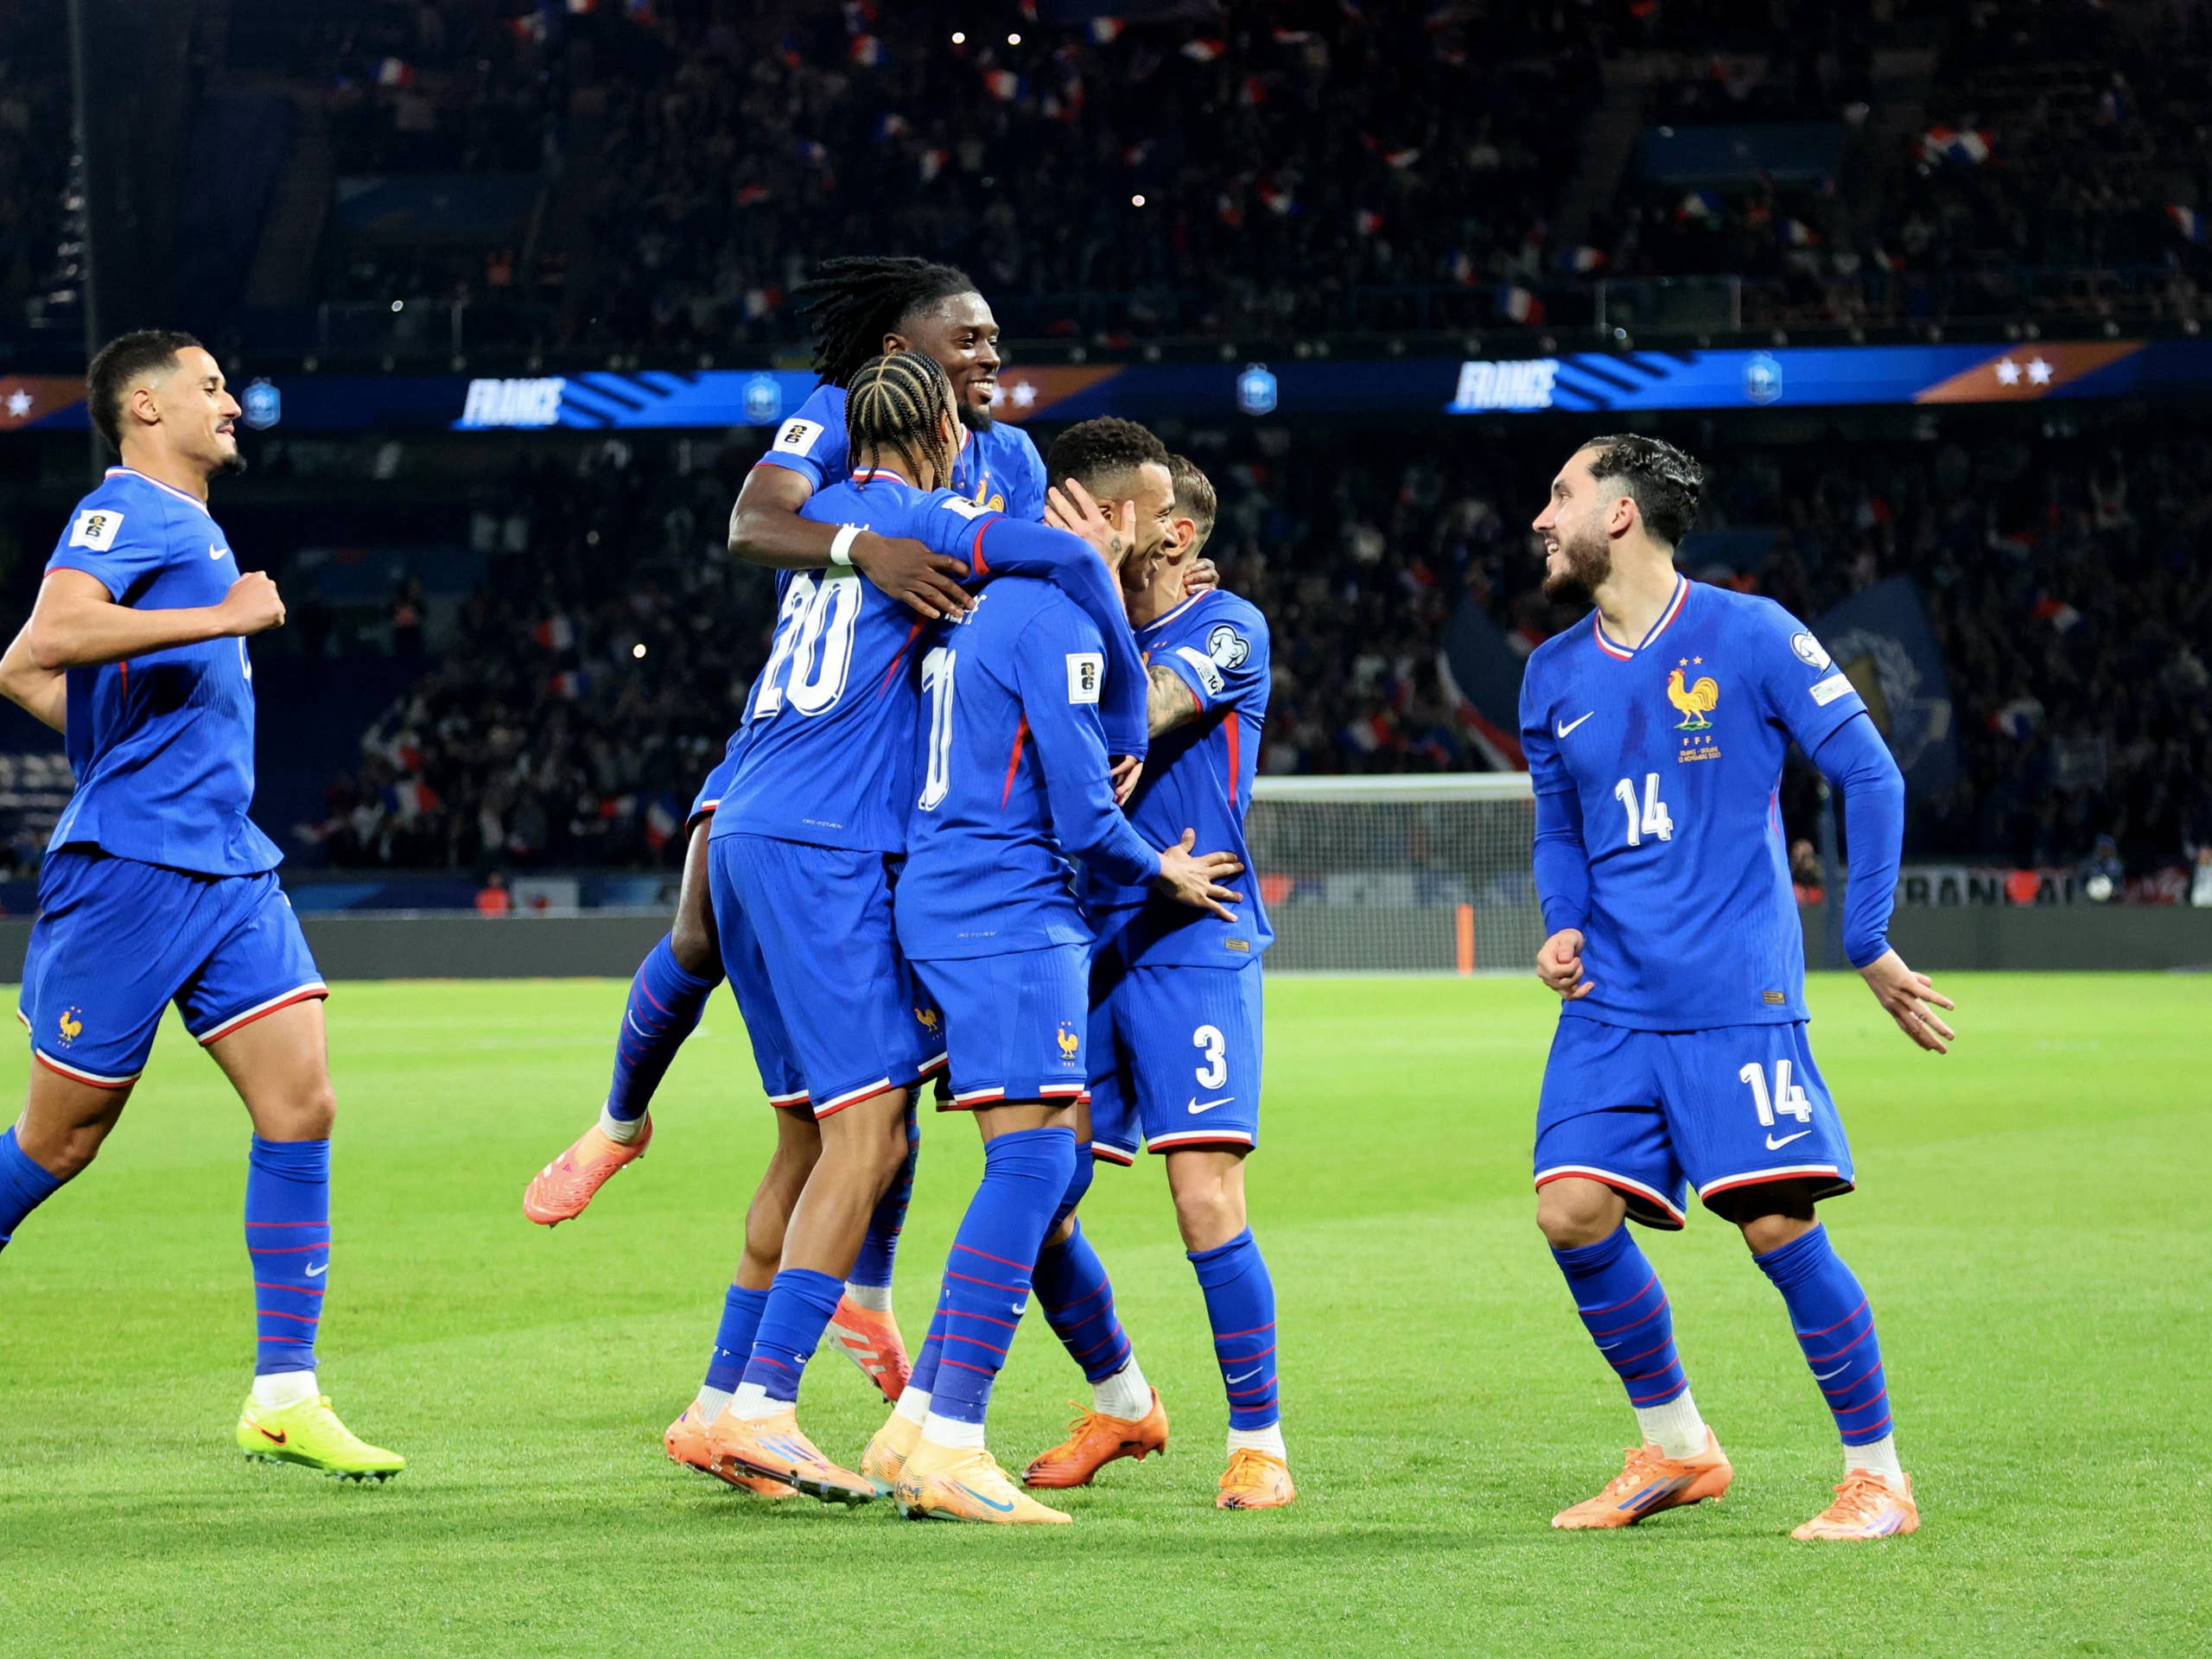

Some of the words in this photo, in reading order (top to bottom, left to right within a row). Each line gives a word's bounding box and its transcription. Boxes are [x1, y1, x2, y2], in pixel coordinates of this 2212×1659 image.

[753, 564, 862, 717] 20
[1615, 772, 1673, 847] 14
[1193, 1025, 1227, 1090] 3
[1739, 1059, 1813, 1127] 14
